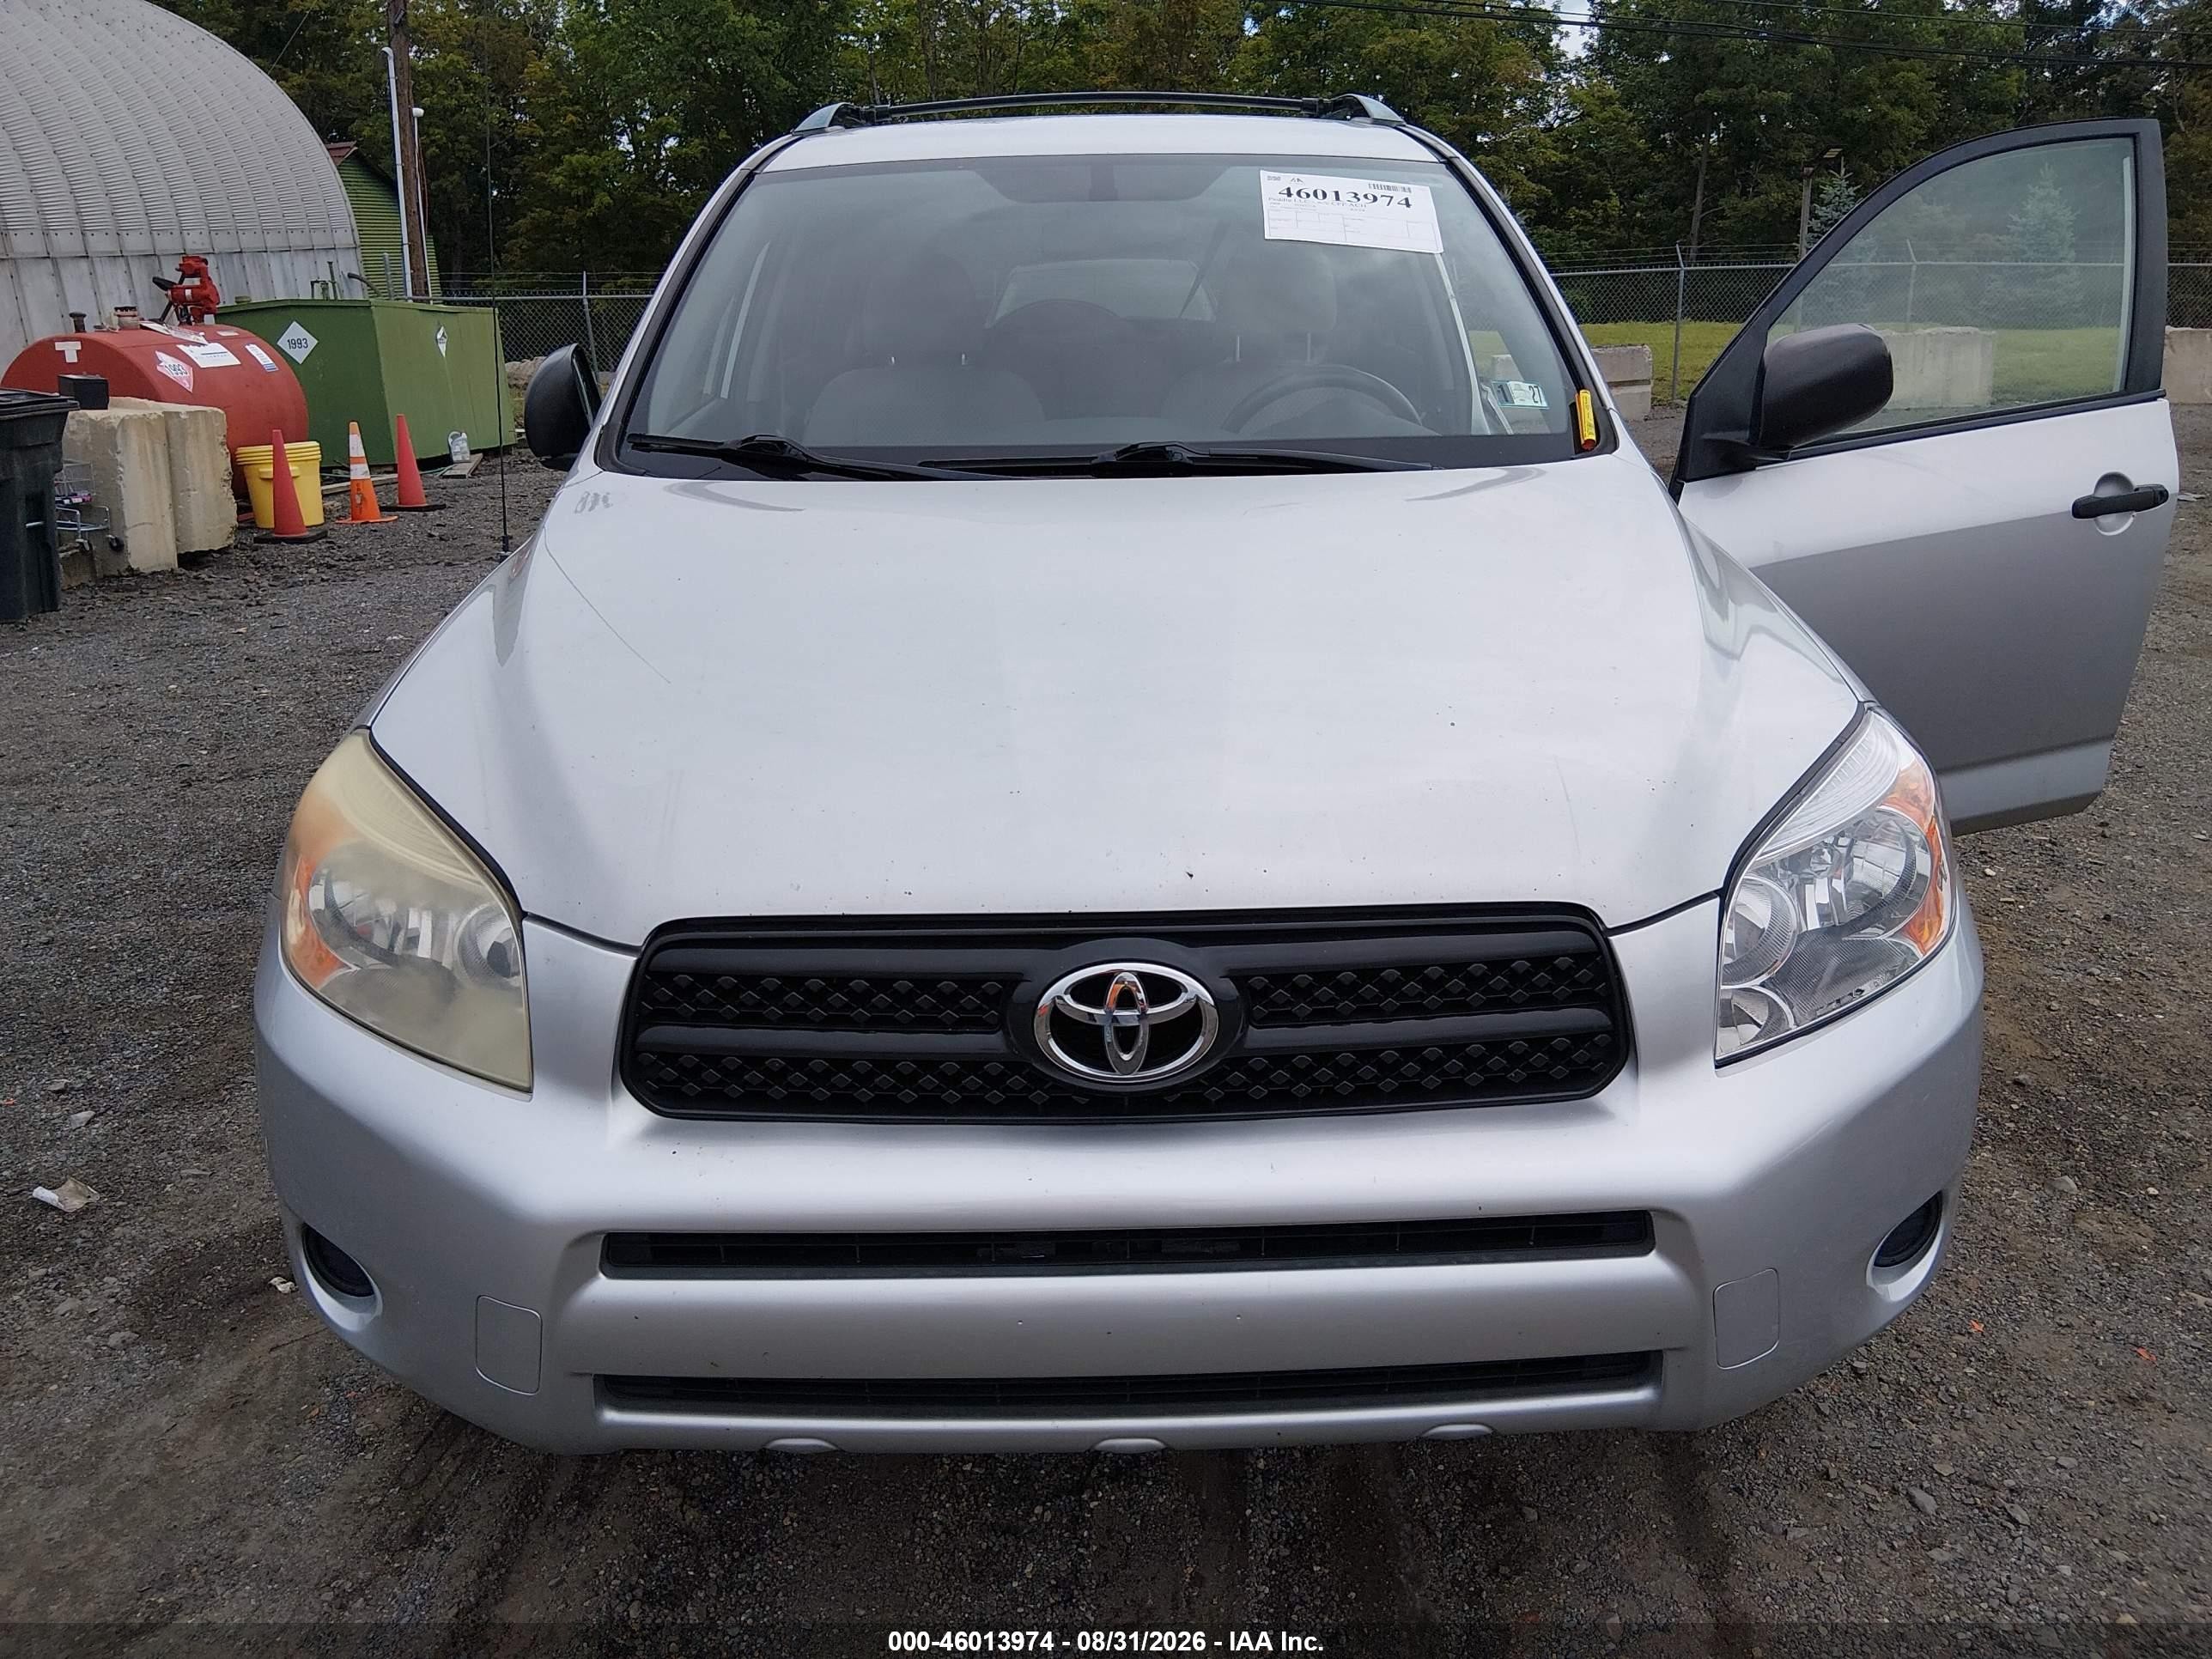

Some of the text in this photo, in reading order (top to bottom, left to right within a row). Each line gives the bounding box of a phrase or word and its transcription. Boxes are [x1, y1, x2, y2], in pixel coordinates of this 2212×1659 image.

[1278, 186, 1413, 209] 46013974
[287, 337, 308, 349] 1993
[164, 363, 188, 376] 1993
[1528, 385, 1543, 405] 27
